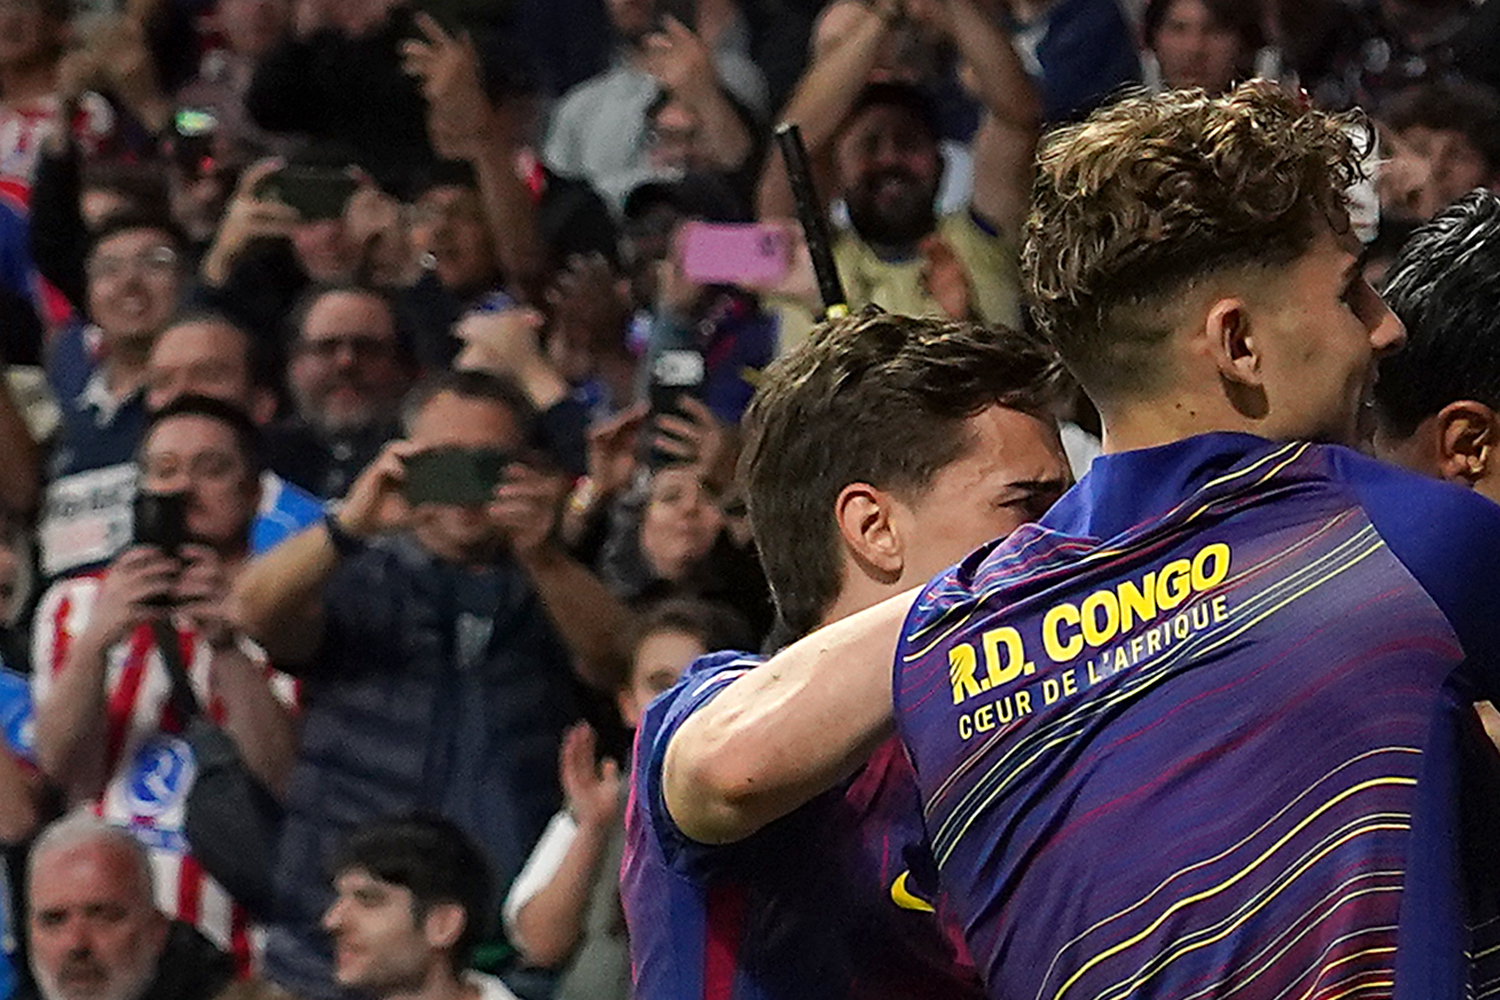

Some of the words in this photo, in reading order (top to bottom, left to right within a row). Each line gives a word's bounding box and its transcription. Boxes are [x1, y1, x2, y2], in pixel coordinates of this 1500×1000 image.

[949, 626, 1036, 705] R.D.
[1042, 543, 1230, 662] CONGO
[959, 691, 1033, 739] CŒUR
[1043, 669, 1078, 705] DE
[1088, 595, 1230, 685] L'AFRIQUE
